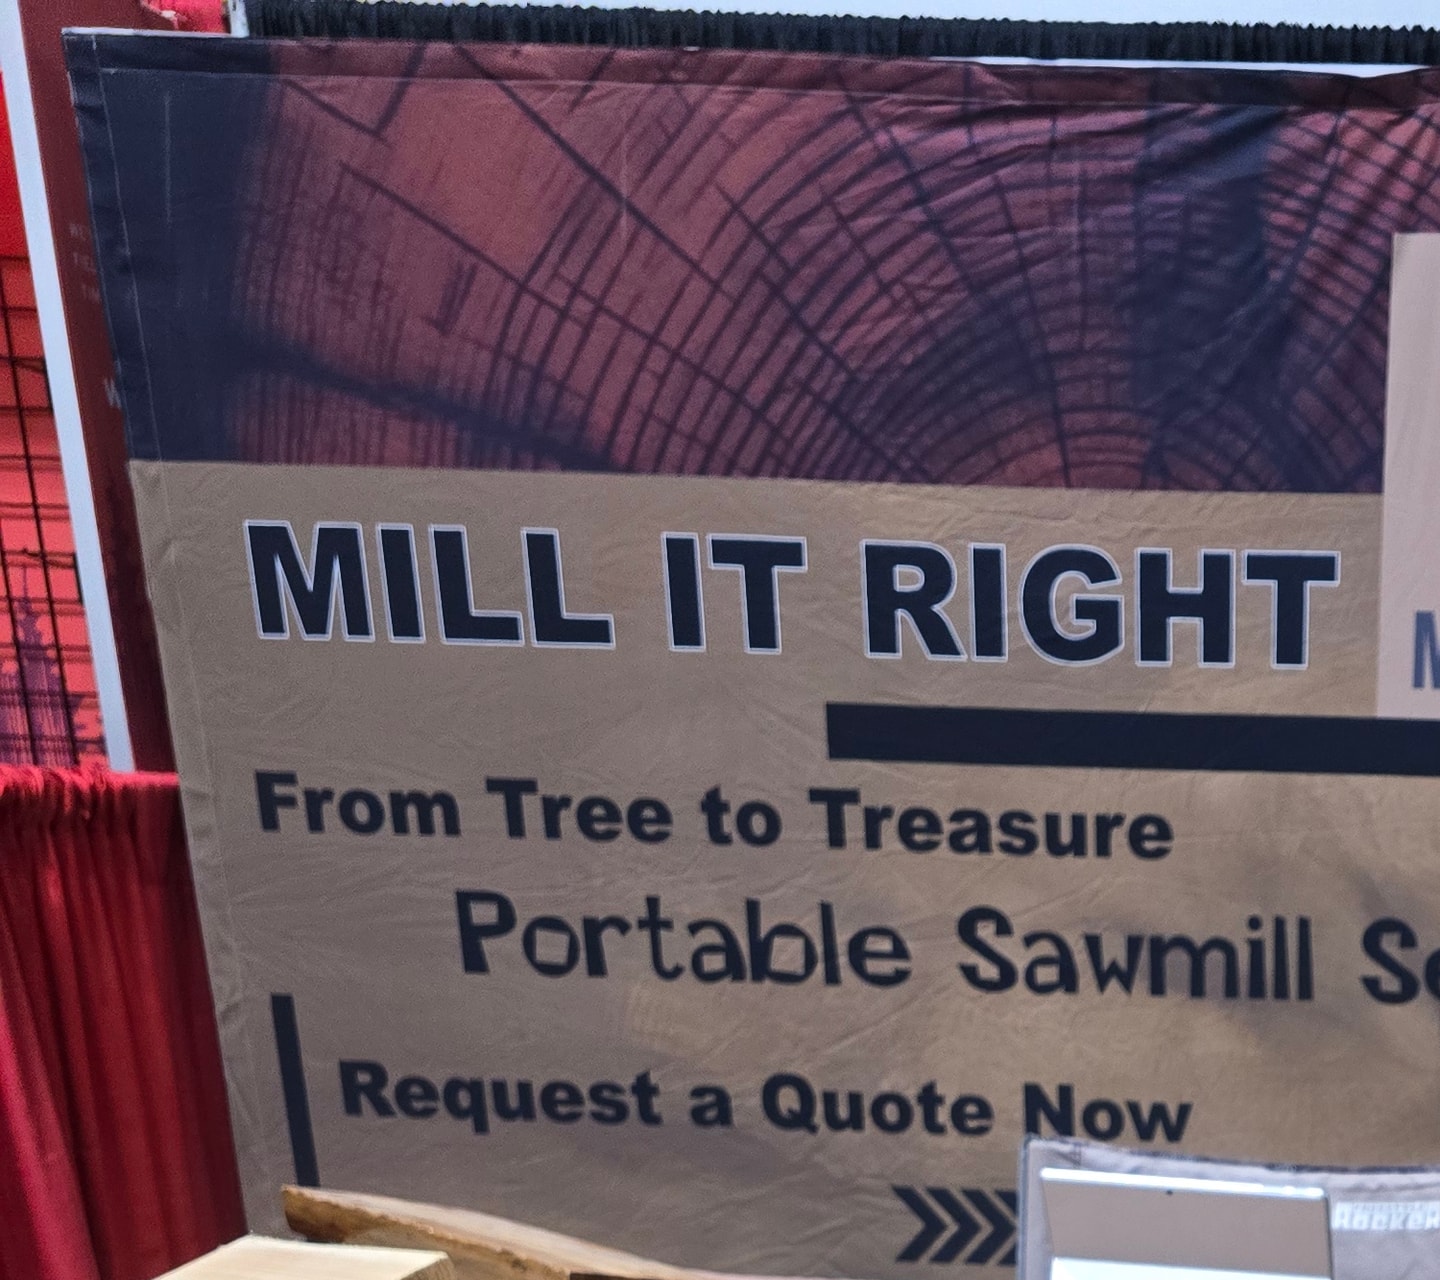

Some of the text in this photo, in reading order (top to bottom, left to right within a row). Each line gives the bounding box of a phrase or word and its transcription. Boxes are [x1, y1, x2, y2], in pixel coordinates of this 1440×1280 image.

[244, 520, 1341, 668] MILL IT RIGHT
[253, 769, 1174, 860] From Tree to Treasure
[455, 888, 912, 988] Portable
[956, 905, 1315, 1003] Sawmill
[338, 1058, 1192, 1144] Request a Quote Now
